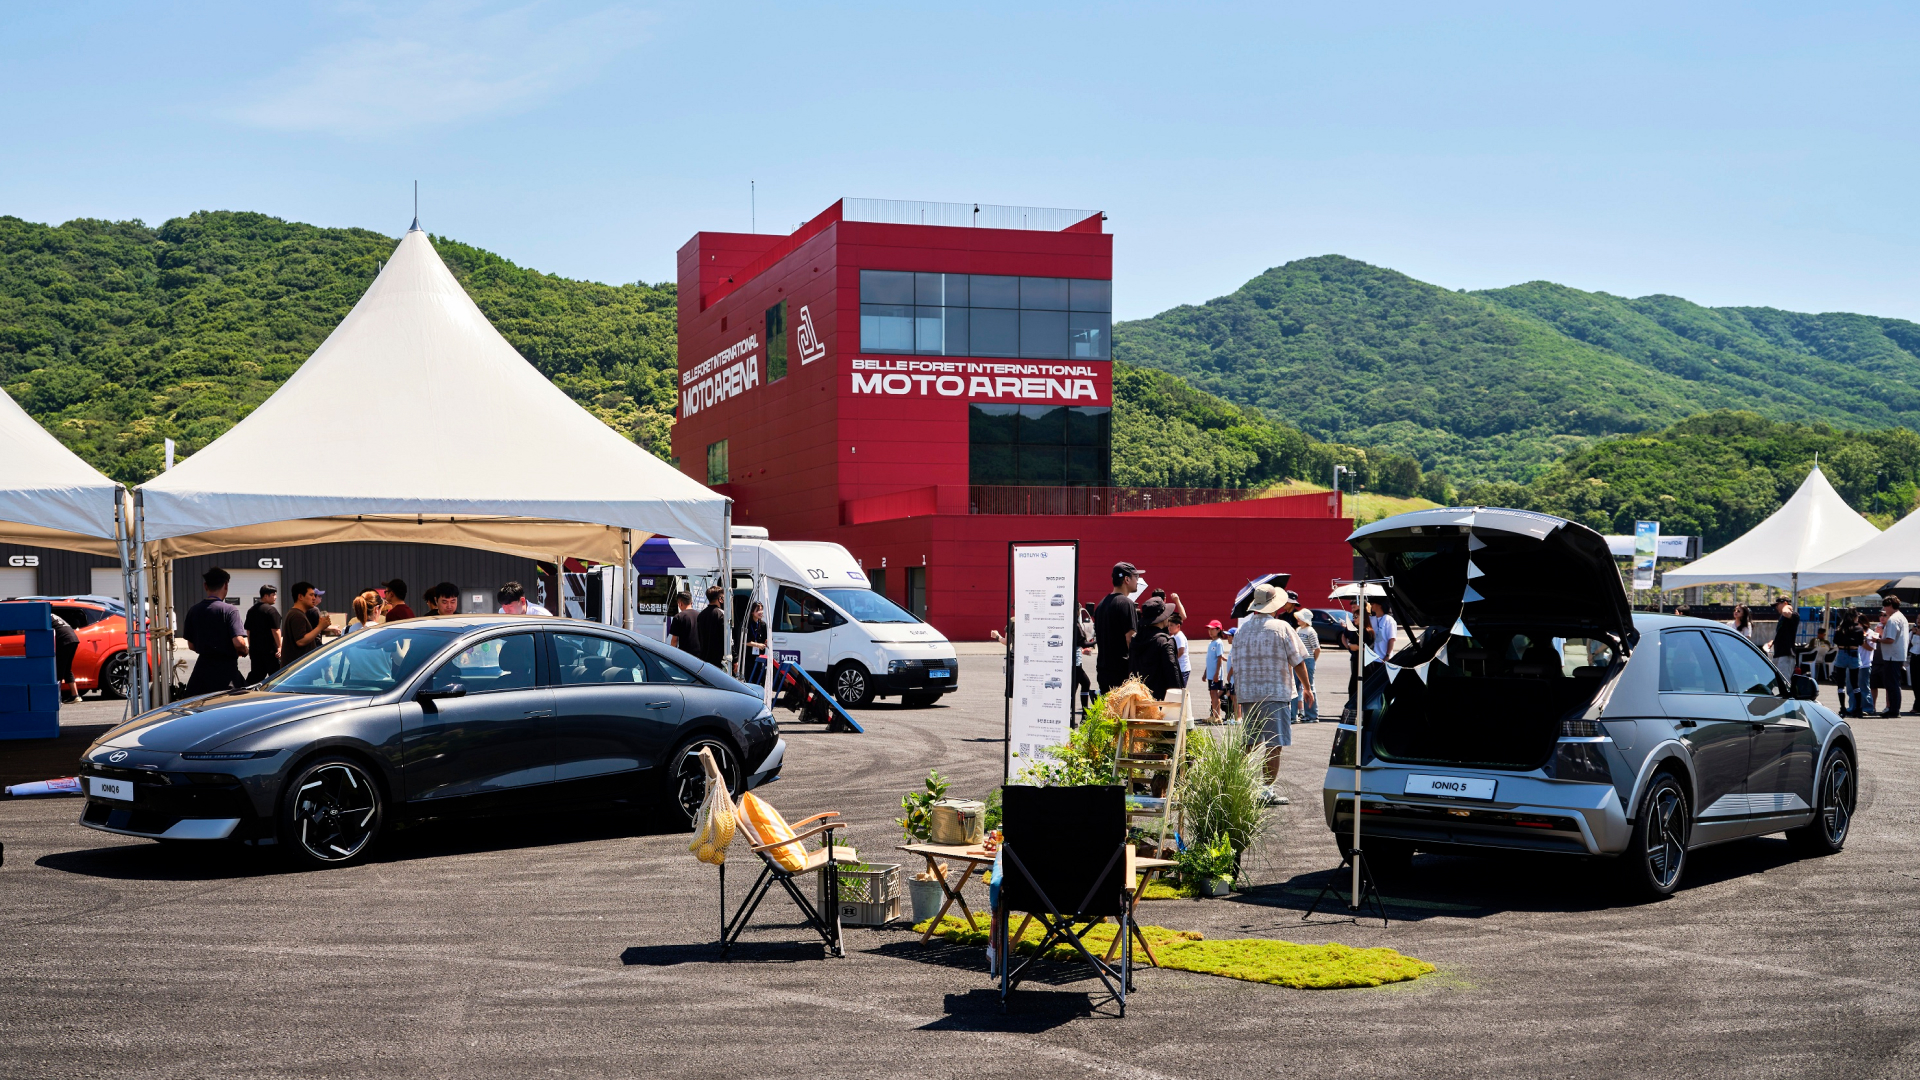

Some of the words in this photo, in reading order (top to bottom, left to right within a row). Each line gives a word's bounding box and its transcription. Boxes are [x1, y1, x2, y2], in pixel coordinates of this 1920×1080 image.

[682, 366, 698, 386] BELLE
[698, 356, 714, 378] FORET
[713, 333, 759, 369] INTERNATIONAL
[852, 359, 908, 371] BELLE
[909, 361, 967, 372] FORET
[967, 363, 1098, 376] INTERNATIONAL
[682, 377, 714, 418] MOTO
[714, 354, 759, 404] ARENA
[851, 372, 965, 396] MOTO
[967, 376, 1098, 400] ARENA
[8, 555, 39, 567] G3
[258, 557, 284, 569] G1
[881, 557, 887, 567] 2
[922, 554, 926, 566] 1
[806, 568, 829, 580] D2
[639, 603, 662, 613] 탄소중립
[102, 784, 115, 794] IONIQ
[116, 786, 120, 794] 6
[1431, 781, 1459, 792] IONIQ
[1460, 783, 1467, 791] 5
